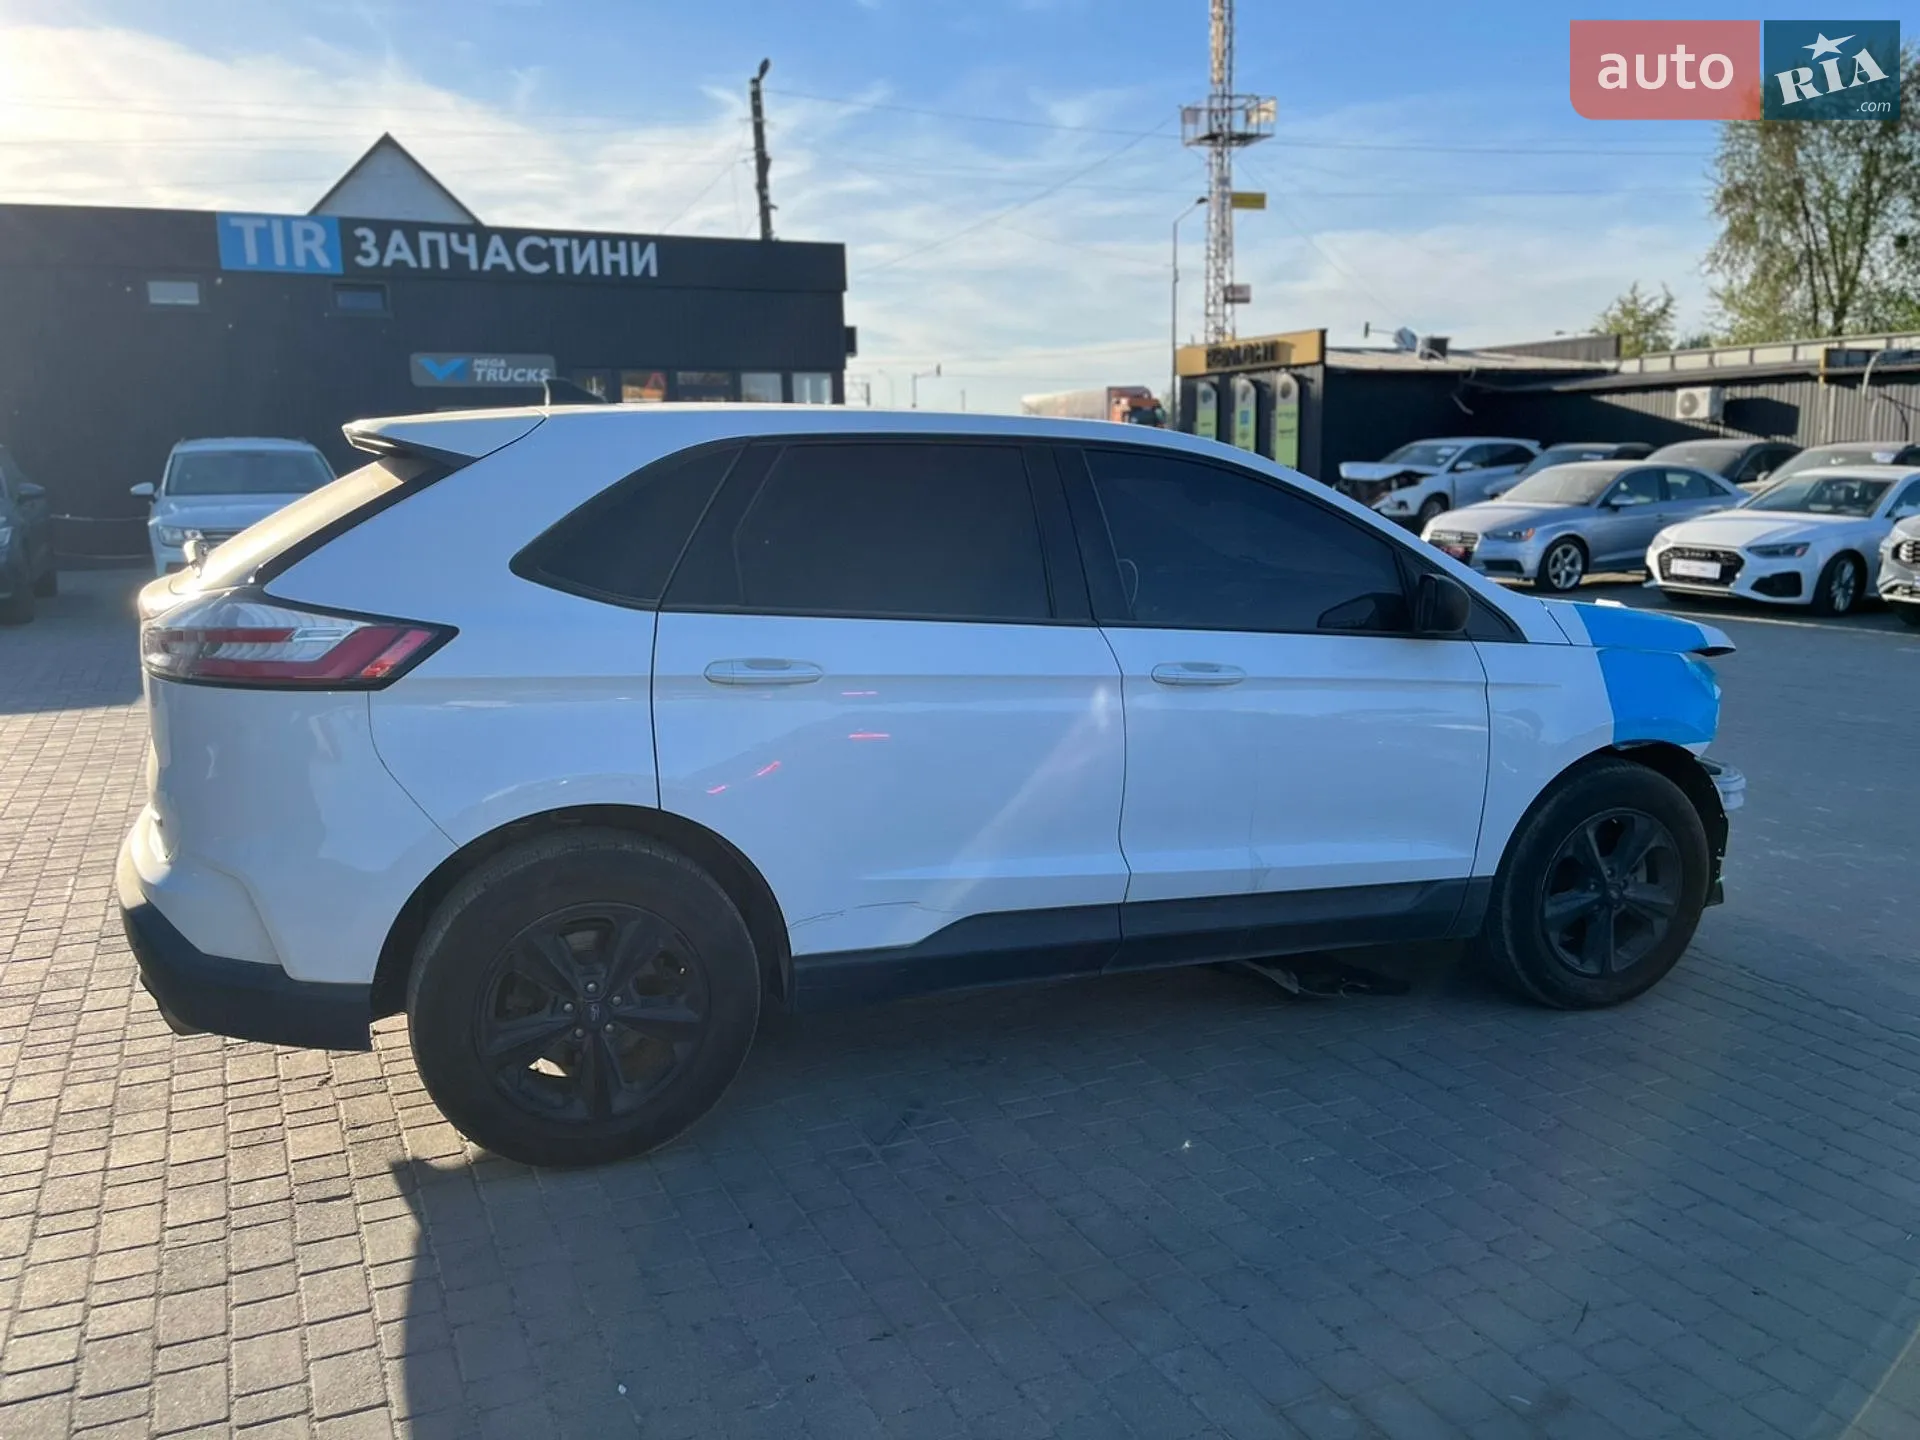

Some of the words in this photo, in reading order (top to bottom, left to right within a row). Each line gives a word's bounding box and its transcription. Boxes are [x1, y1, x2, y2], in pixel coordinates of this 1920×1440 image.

[229, 217, 332, 269] TIR
[353, 227, 659, 278] ЗАПЧАСТИНИ
[473, 358, 507, 368] MEGA
[474, 368, 551, 383] TRUCKS
